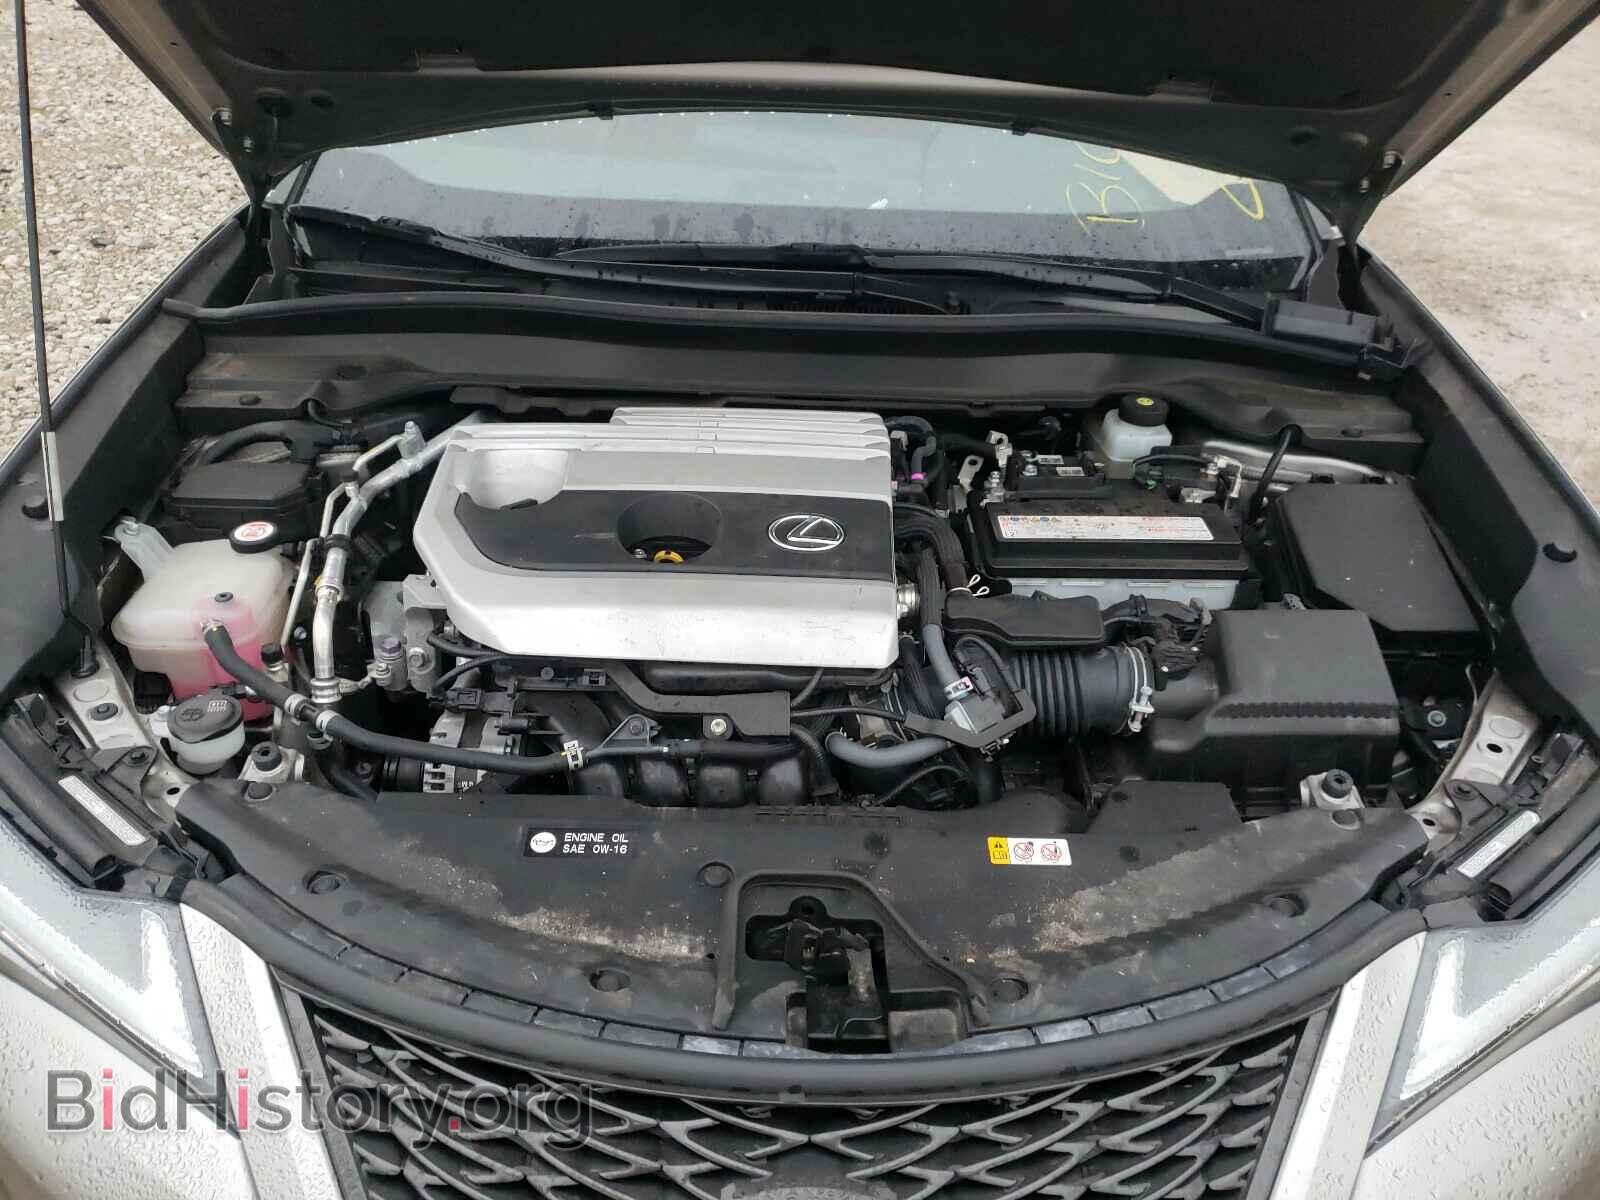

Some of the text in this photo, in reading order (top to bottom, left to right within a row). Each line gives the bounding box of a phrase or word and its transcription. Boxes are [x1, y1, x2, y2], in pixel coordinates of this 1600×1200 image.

[564, 832, 629, 843] ENGINE OIL
[562, 843, 586, 854] SAE
